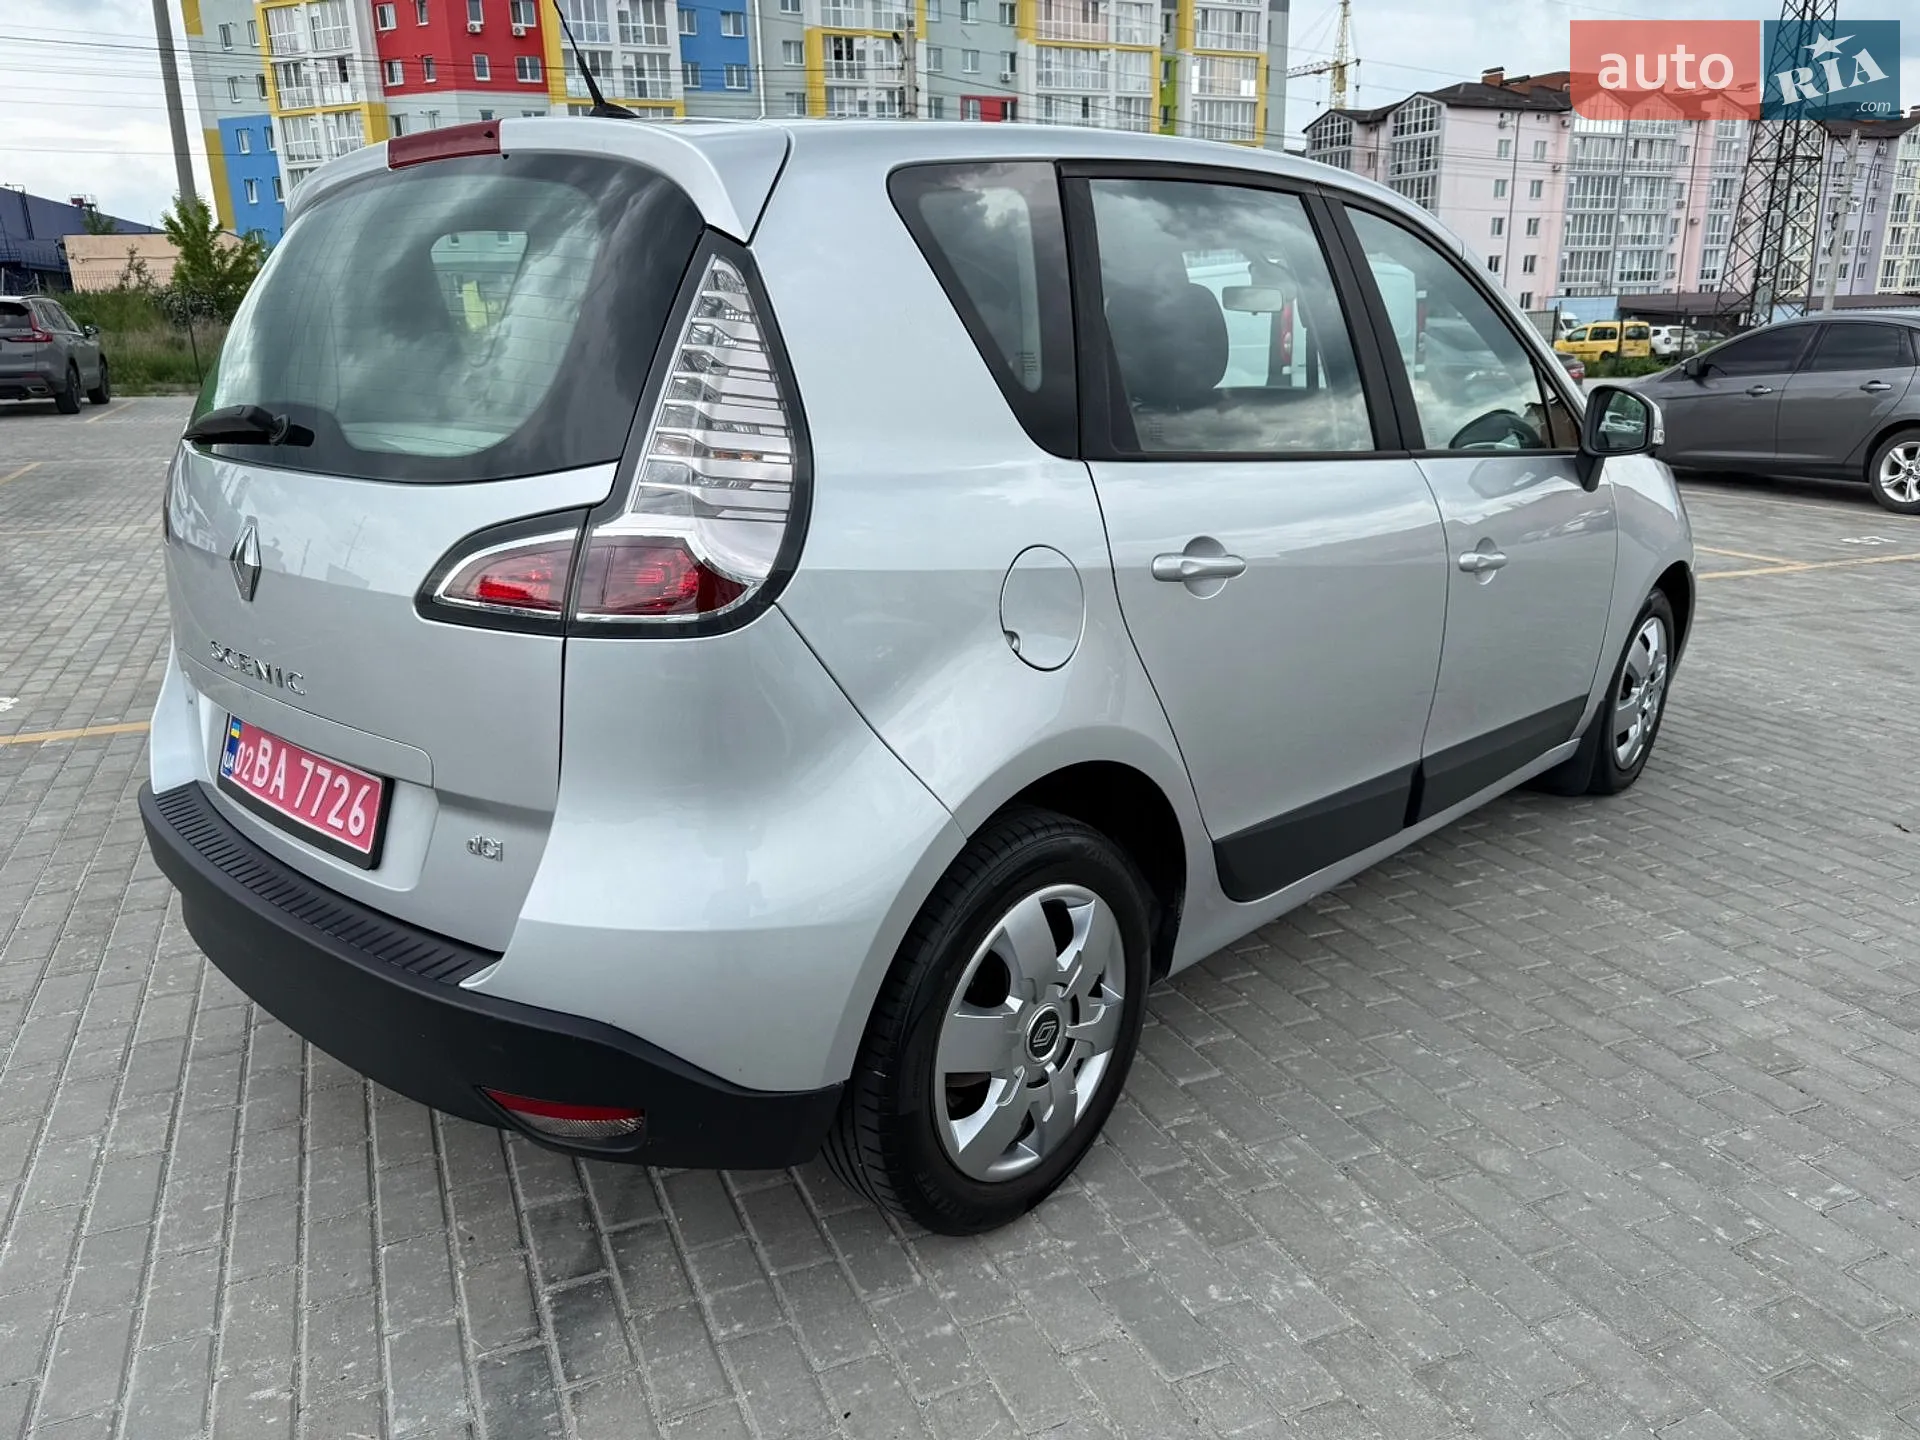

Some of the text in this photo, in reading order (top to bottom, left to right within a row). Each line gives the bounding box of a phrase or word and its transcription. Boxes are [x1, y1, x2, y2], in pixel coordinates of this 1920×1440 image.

[210, 640, 306, 696] SCENIC
[223, 750, 236, 770] UA
[294, 757, 371, 837] 7726
